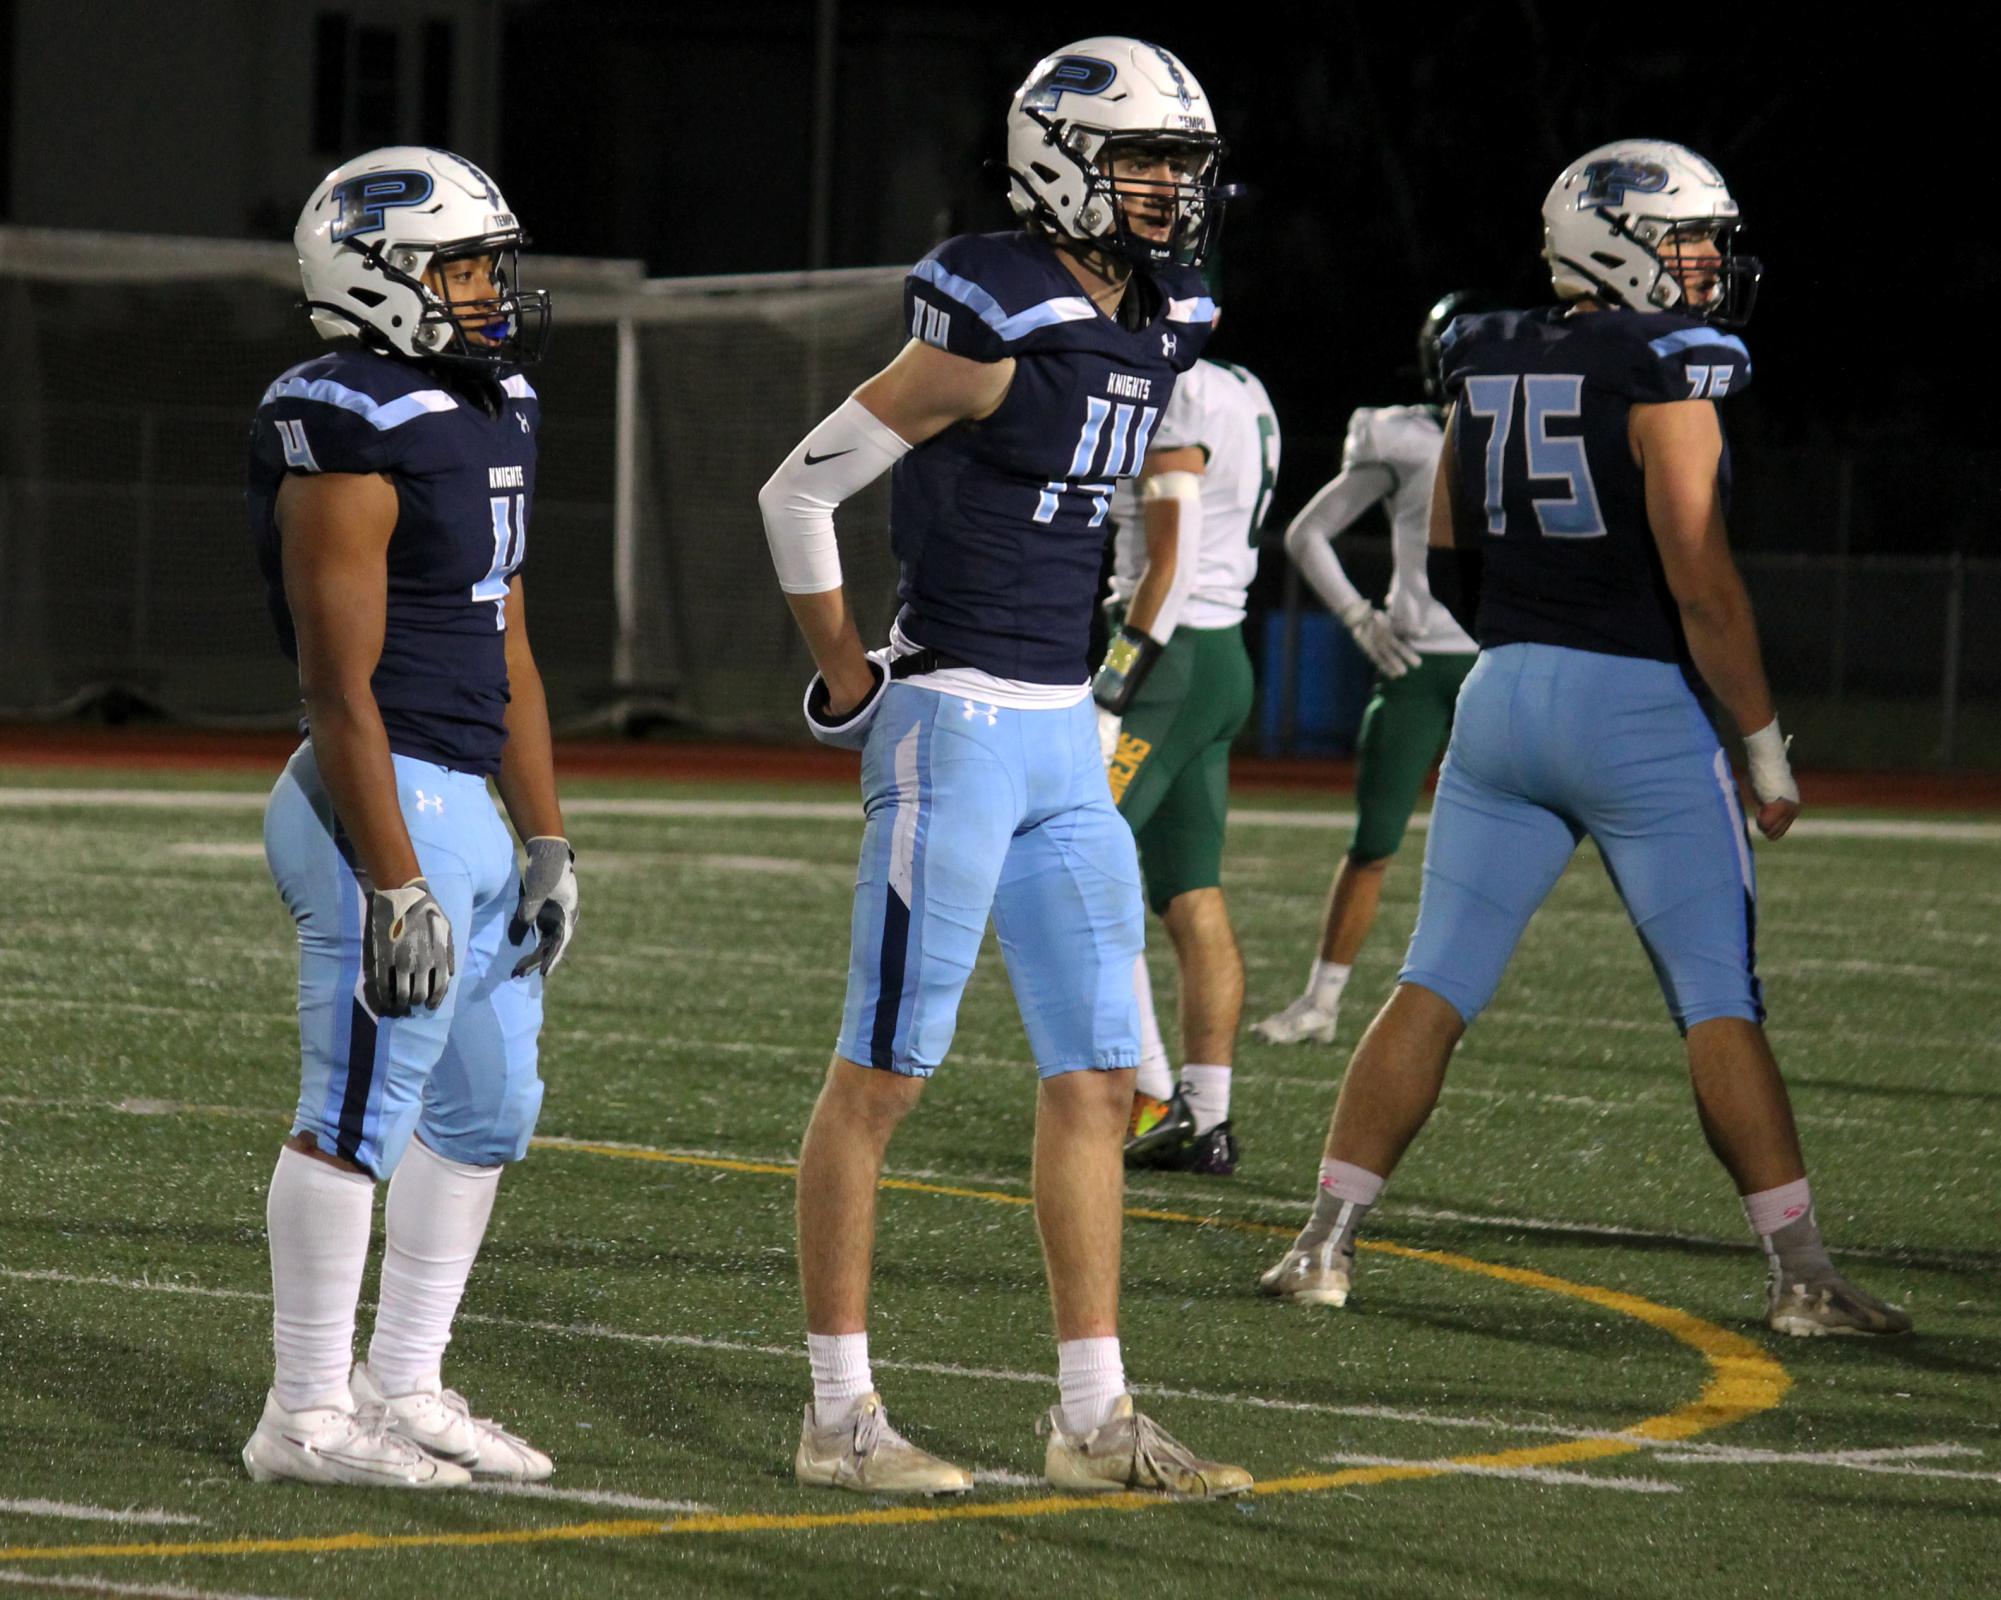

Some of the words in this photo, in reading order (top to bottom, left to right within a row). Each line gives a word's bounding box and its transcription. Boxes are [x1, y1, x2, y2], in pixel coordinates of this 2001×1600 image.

[1019, 56, 1117, 112] P
[331, 169, 434, 243] P
[1577, 158, 1669, 211] P
[1107, 372, 1151, 400] KNIGHTS
[274, 419, 322, 472] 4
[1033, 396, 1158, 527] 14
[1465, 374, 1607, 538] 75
[489, 465, 524, 489] KNIGHTS
[472, 494, 525, 631] 4
